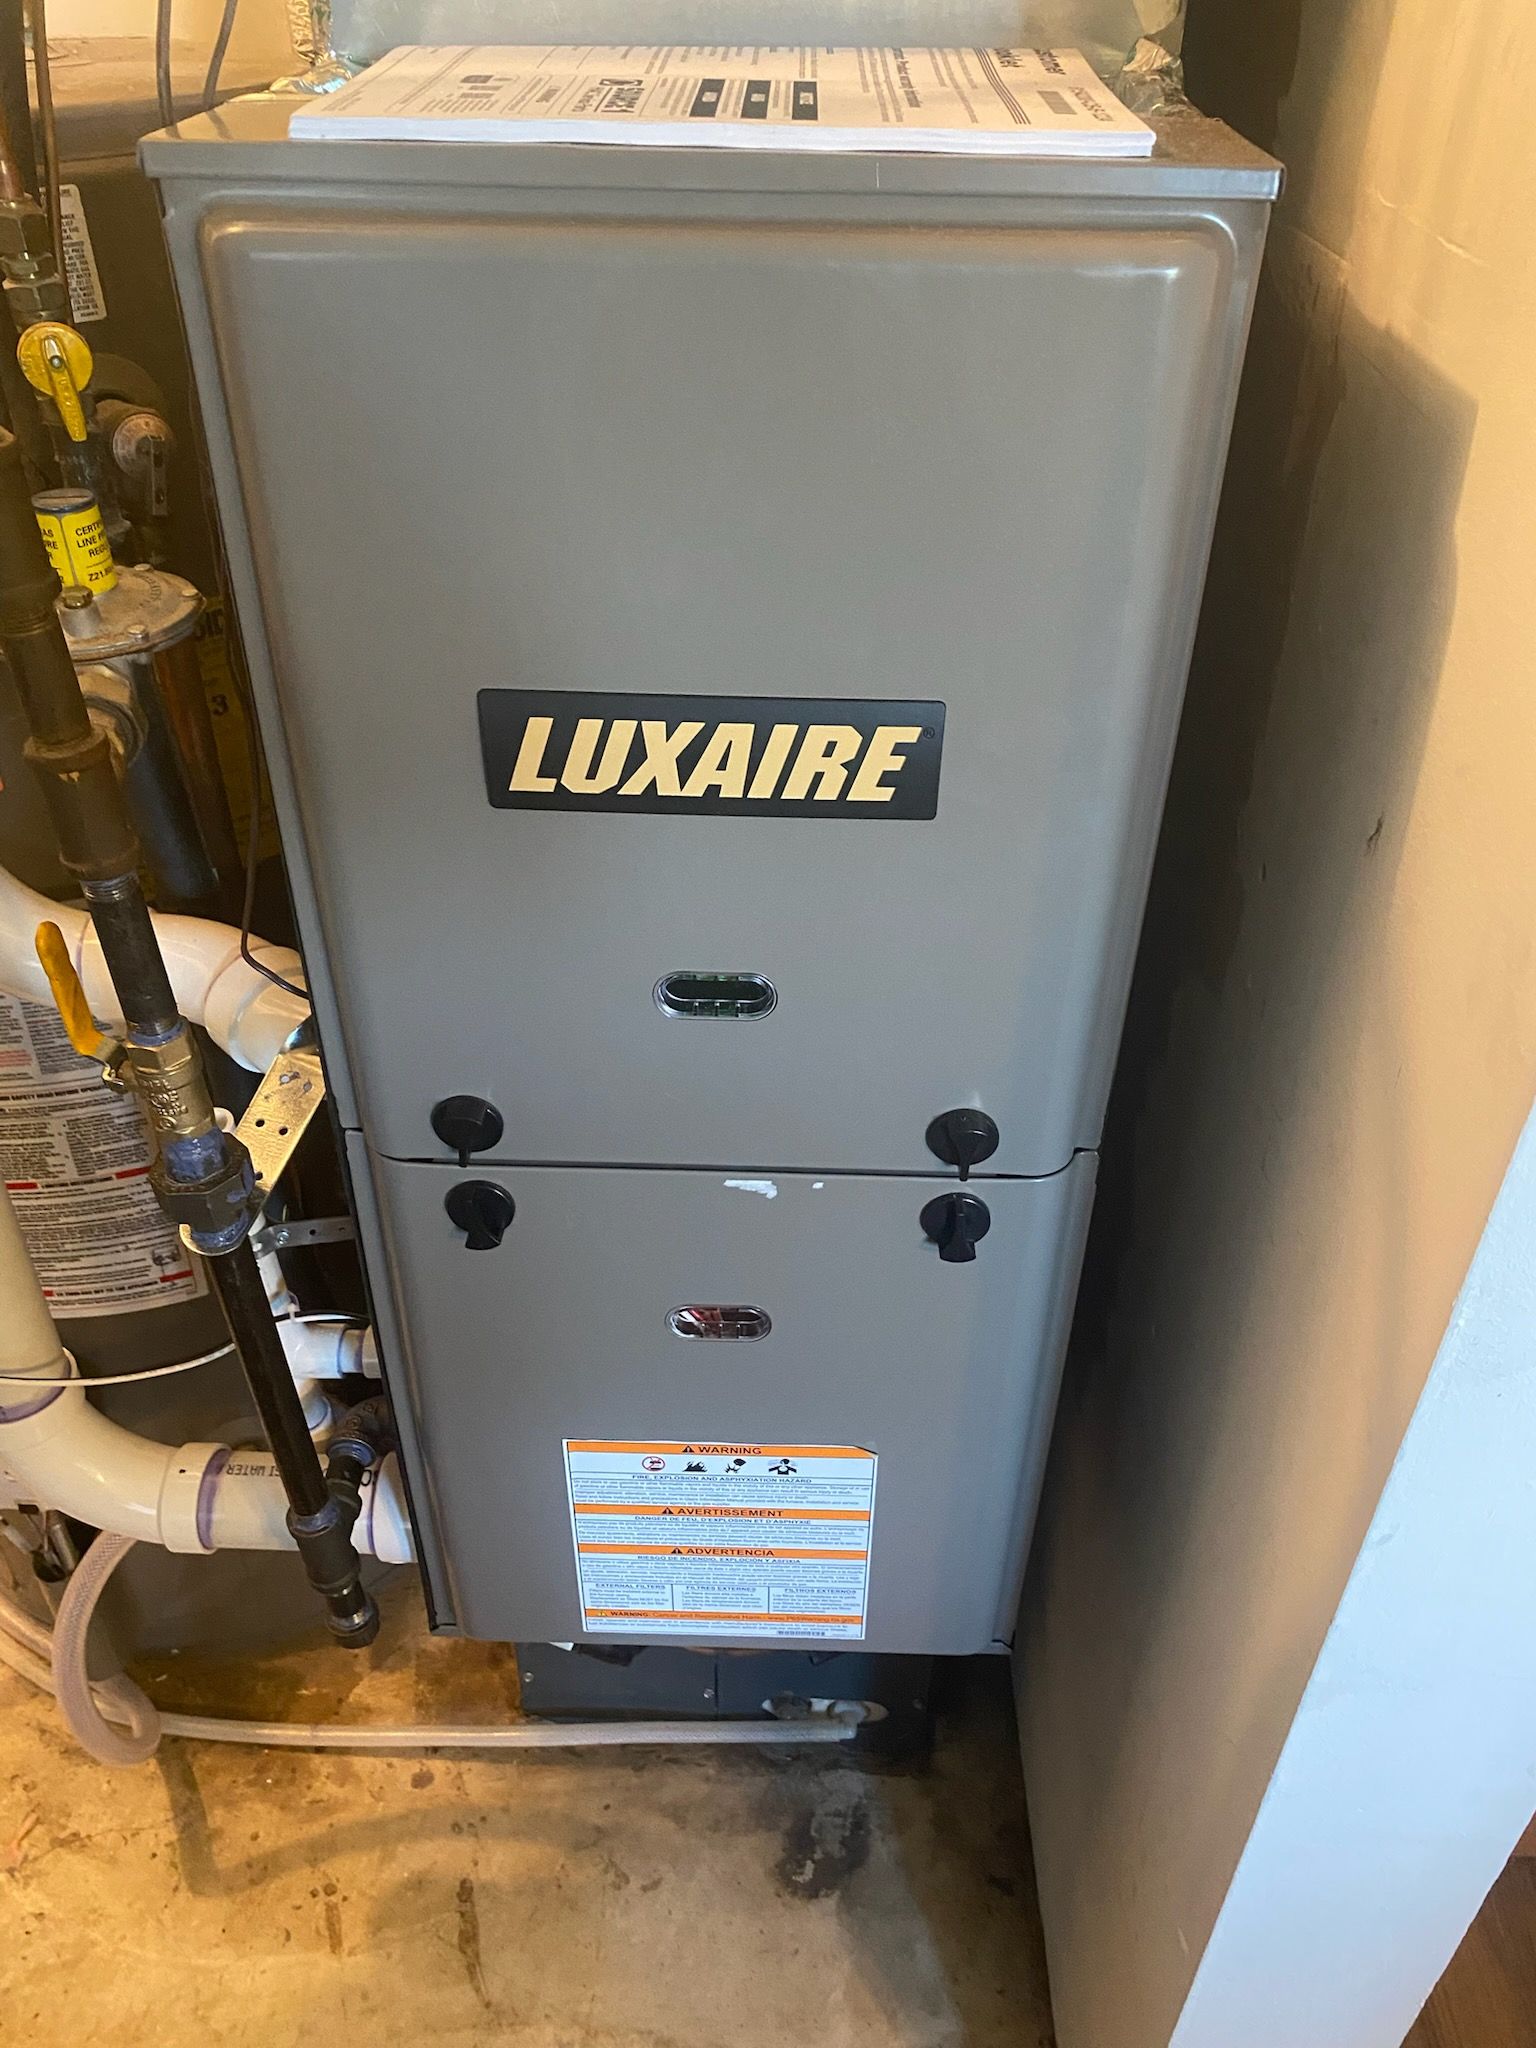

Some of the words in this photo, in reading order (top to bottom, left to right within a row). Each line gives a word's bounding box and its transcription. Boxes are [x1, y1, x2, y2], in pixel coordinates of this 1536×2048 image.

[76, 536, 97, 548] LINE
[508, 716, 923, 802] LUXAIRE
[698, 1446, 762, 1455] WARNING
[226, 1464, 266, 1477] WATER
[677, 1508, 784, 1517] AVERTISSEMENT
[686, 1548, 775, 1556] ADVERTENCIA
